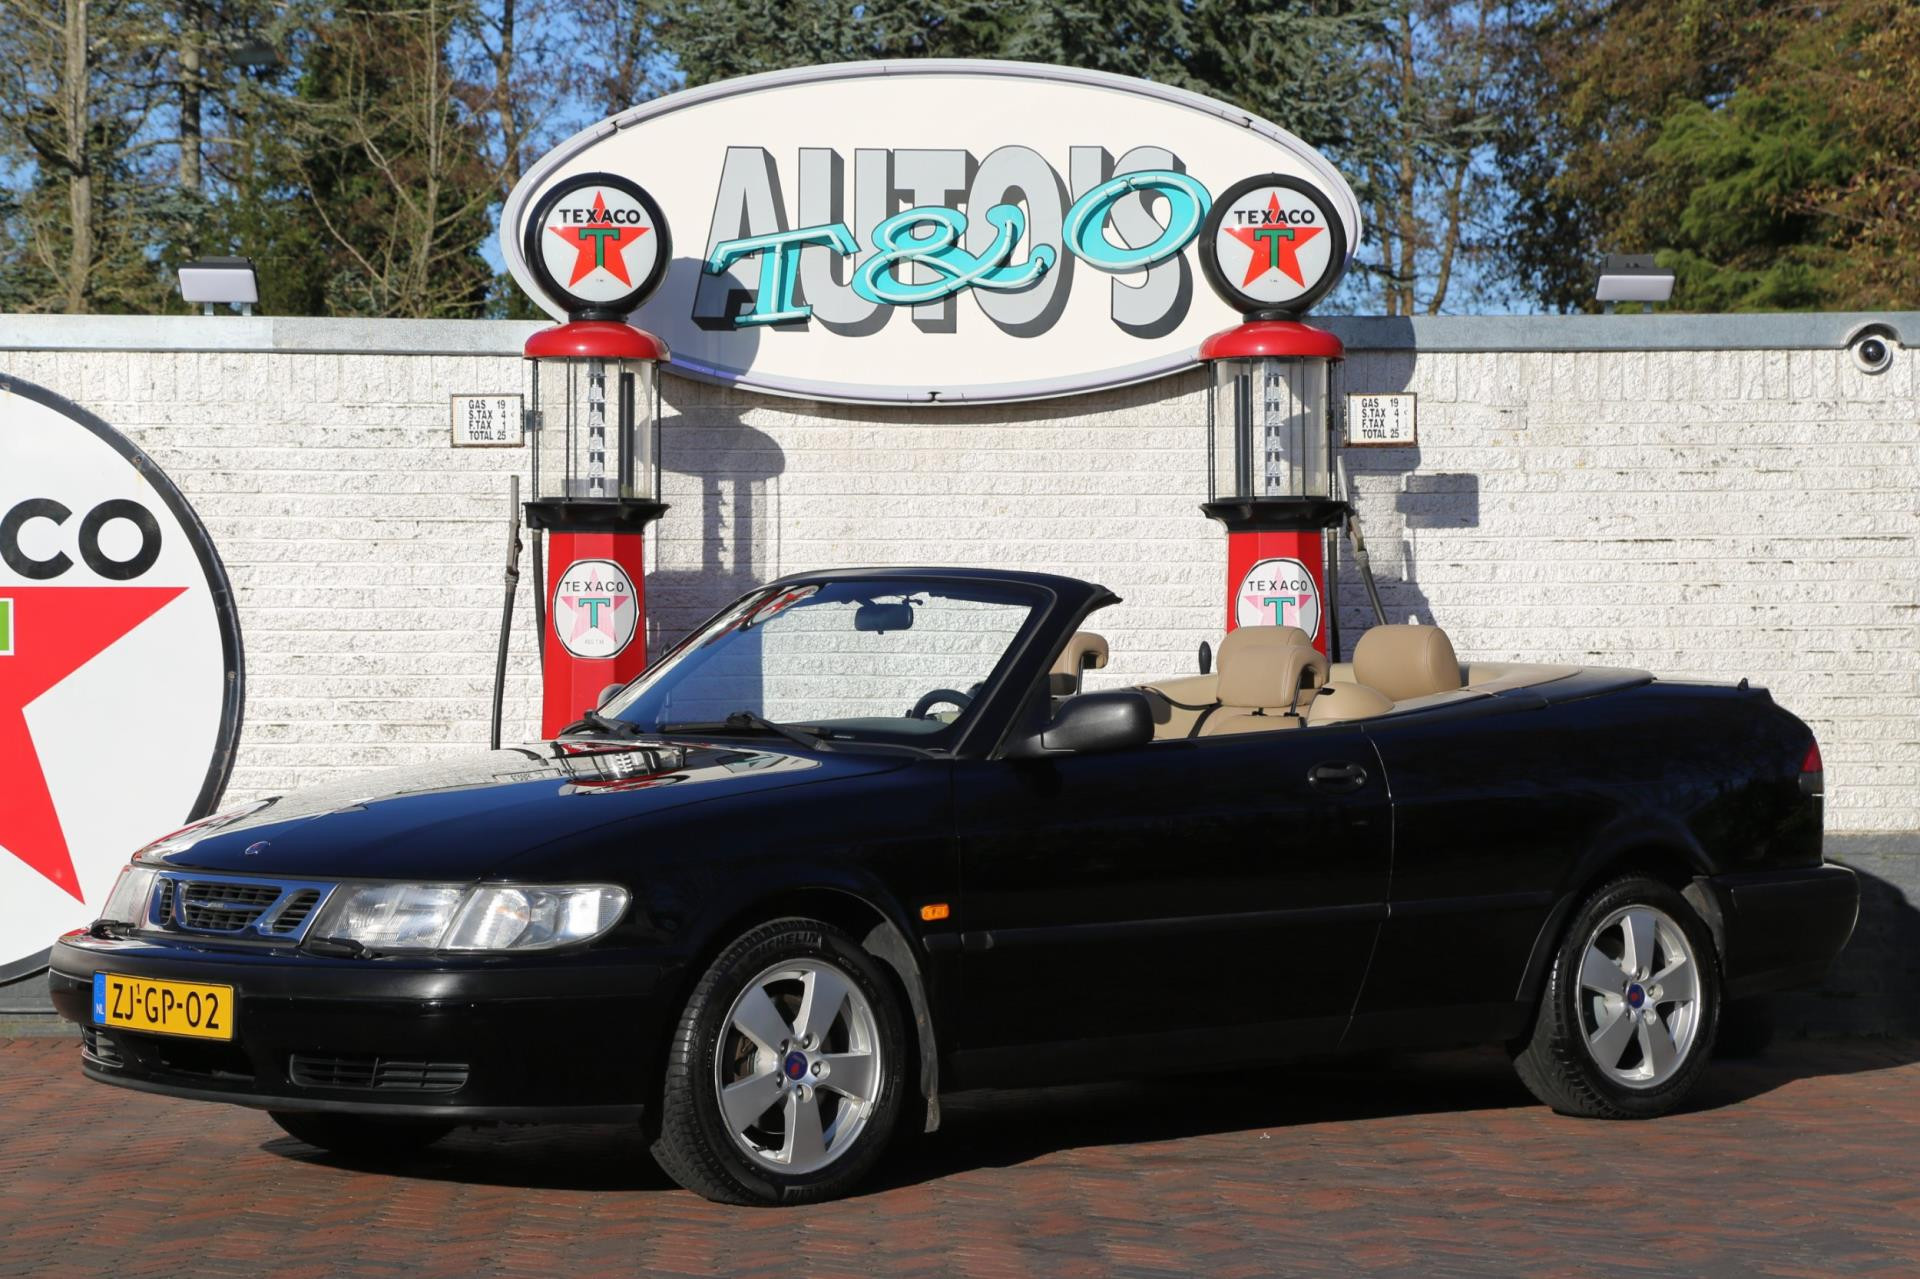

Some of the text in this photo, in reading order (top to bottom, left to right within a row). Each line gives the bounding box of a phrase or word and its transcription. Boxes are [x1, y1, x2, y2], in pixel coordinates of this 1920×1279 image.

[559, 208, 641, 225] TEXACO
[1234, 209, 1315, 225] TEXACO
[692, 145, 1193, 339] AUTO'S
[578, 227, 621, 269] T
[1253, 228, 1296, 269] T
[468, 399, 506, 409] GAS 19
[1361, 398, 1399, 407] GAS 19
[468, 410, 506, 419] S.TAX 4
[1362, 409, 1399, 418] S.TAX 4
[468, 421, 492, 430] F.TAX
[1362, 419, 1385, 428] F.TAX
[469, 431, 506, 441] TOTAL 25
[1362, 429, 1400, 439] TOTAL 25
[0, 497, 162, 581] CO
[565, 581, 625, 592] TEXACO
[1248, 580, 1308, 592] TEXACO
[95, 1003, 105, 1015] NL
[112, 982, 220, 1030] ZJ-GP-02
